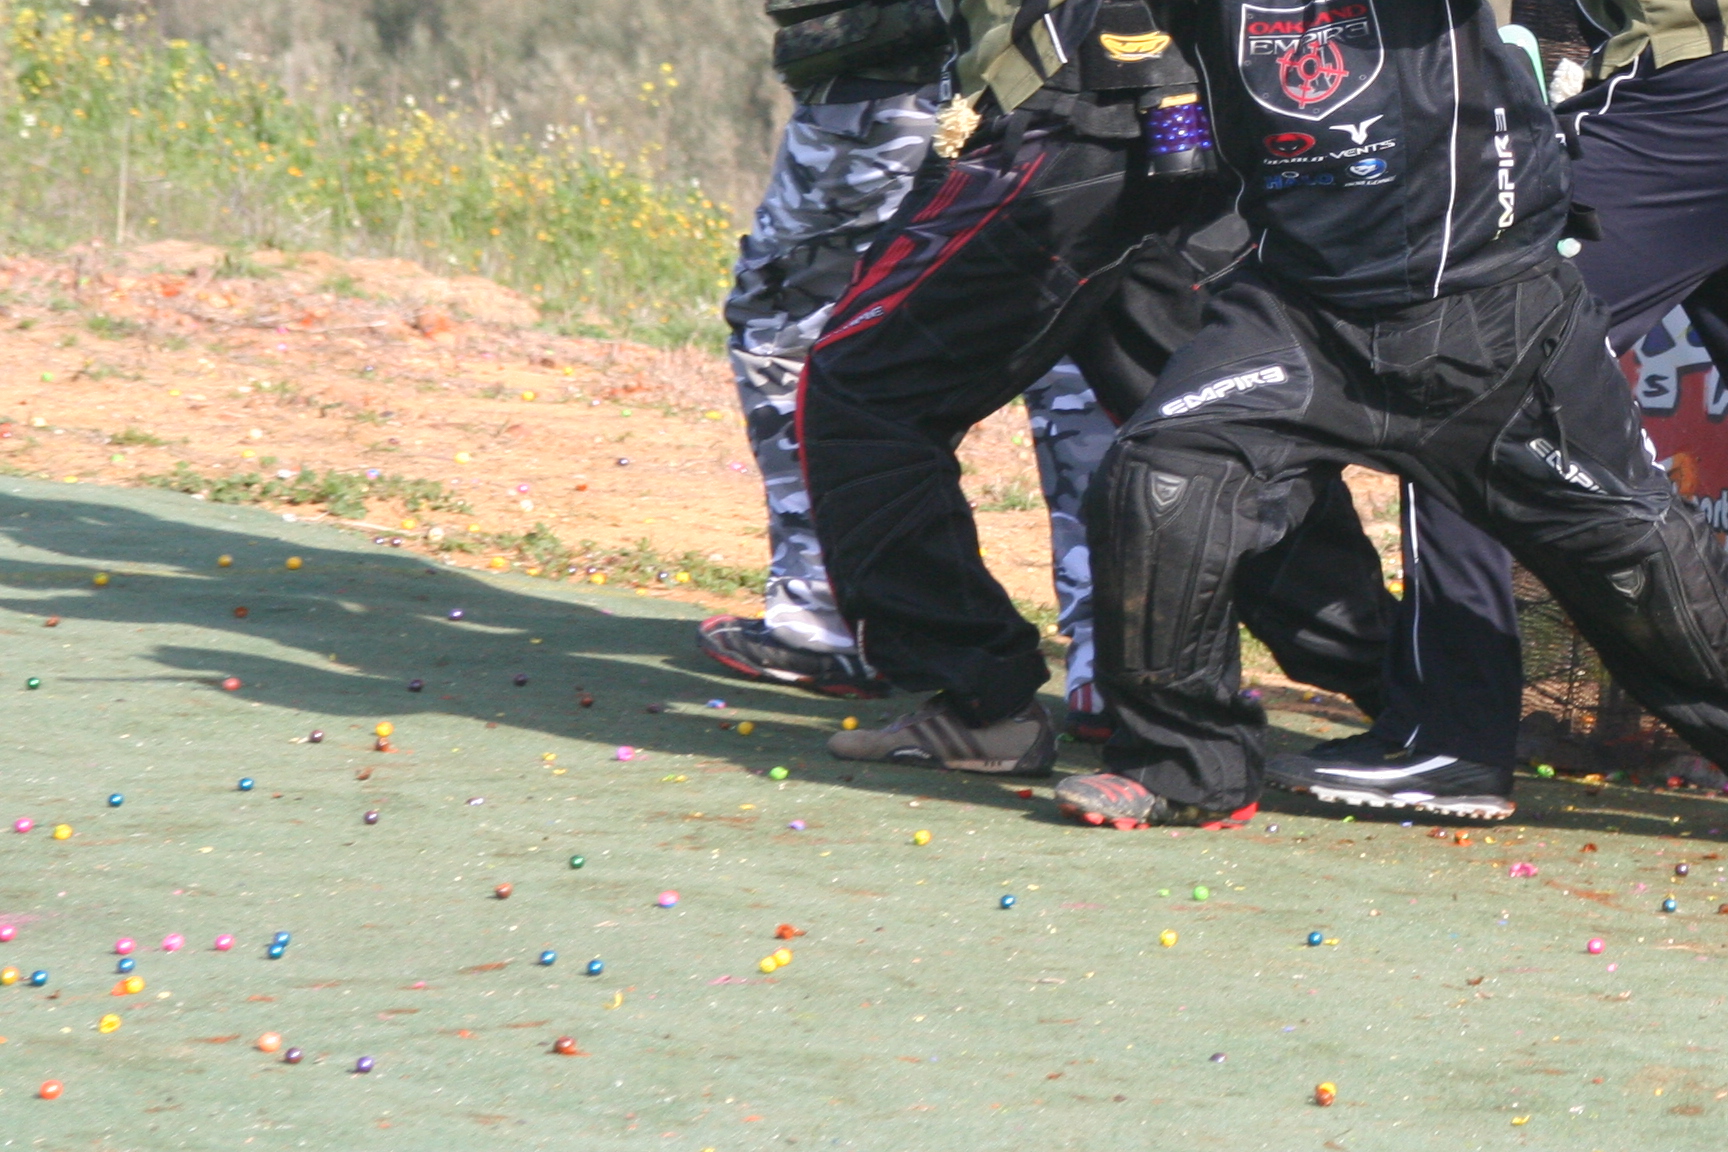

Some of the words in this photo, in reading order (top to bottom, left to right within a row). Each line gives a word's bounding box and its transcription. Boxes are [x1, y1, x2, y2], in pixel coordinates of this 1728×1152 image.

[1247, 4, 1368, 35] OAKAND
[1329, 138, 1397, 159] VENTS
[1491, 107, 1516, 241] MPIRE
[1160, 365, 1287, 416] EMPIRE
